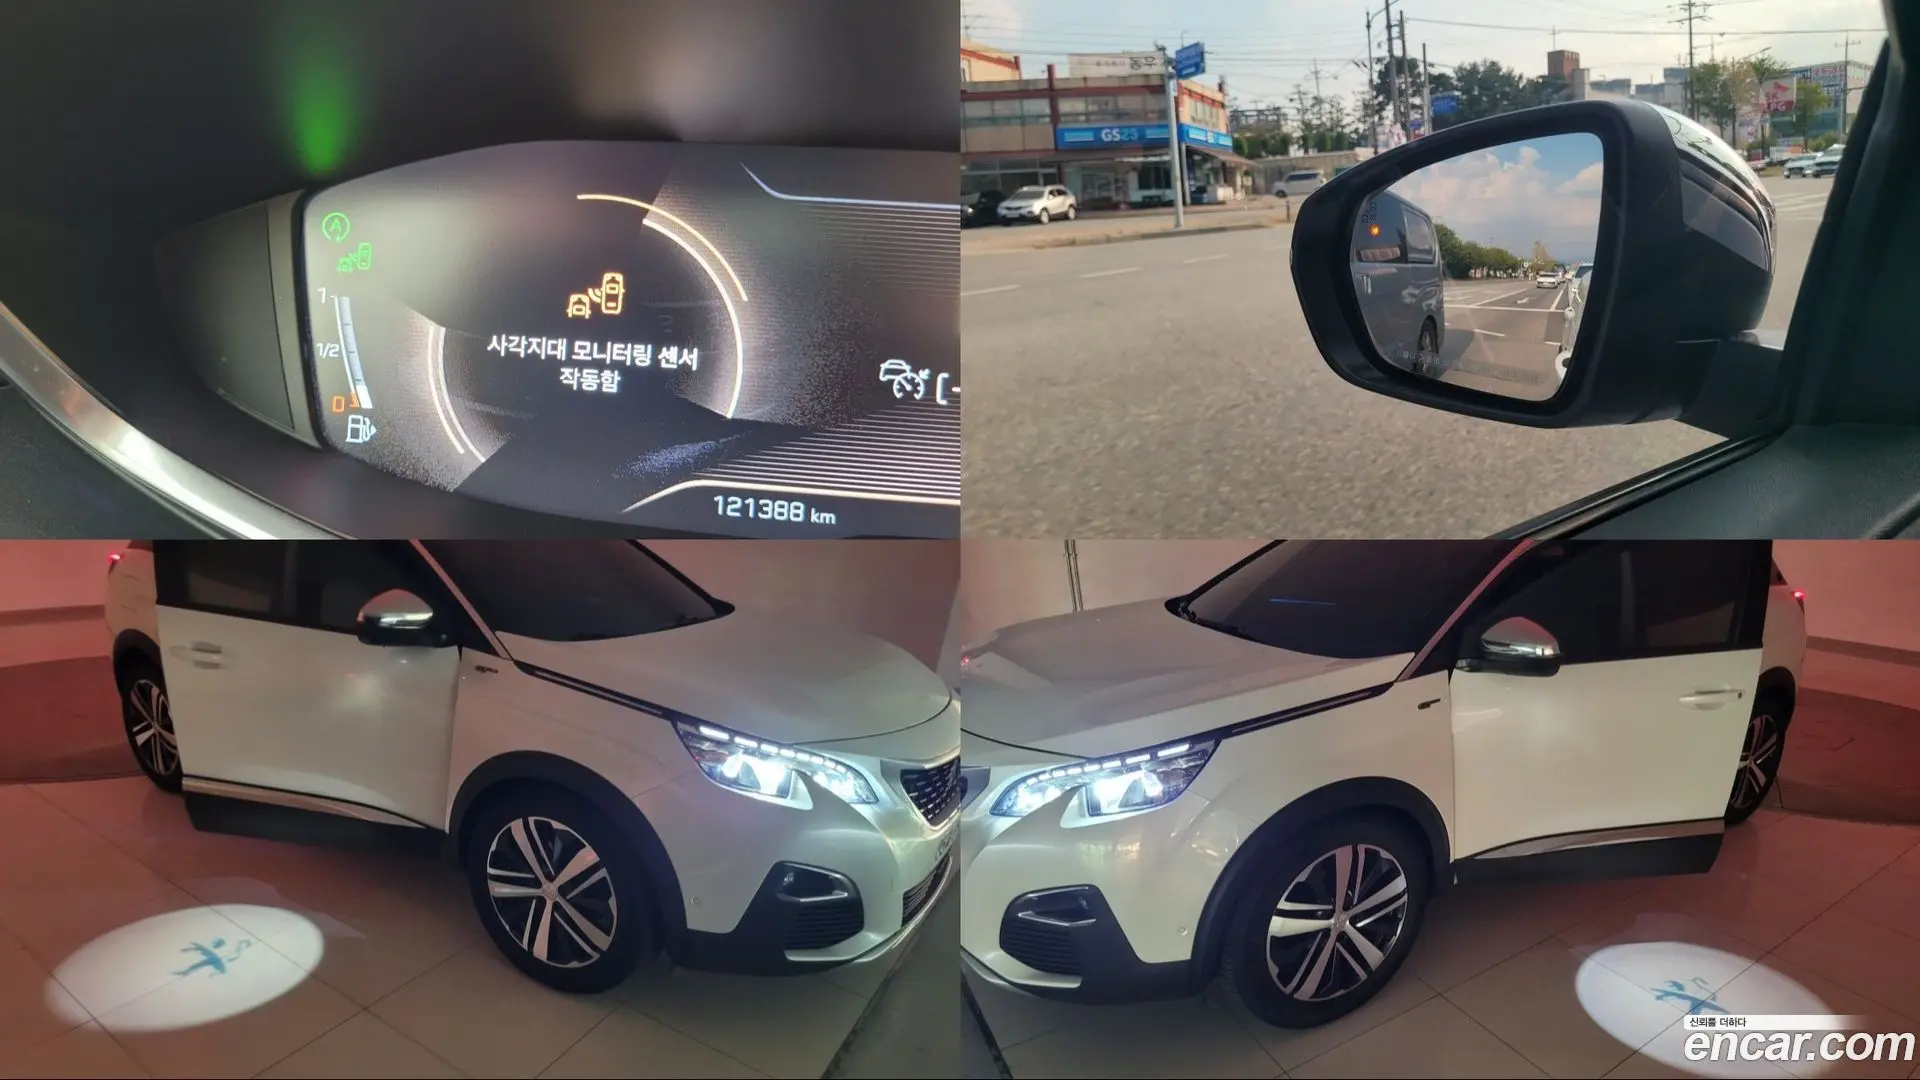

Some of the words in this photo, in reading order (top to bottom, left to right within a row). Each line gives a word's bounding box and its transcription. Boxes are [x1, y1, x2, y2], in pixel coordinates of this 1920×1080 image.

[1101, 128, 1139, 142] GS25
[316, 342, 340, 359] 1/2
[487, 334, 567, 361] 사각지대
[571, 340, 652, 367] 모니터링
[658, 346, 698, 371] 센서
[560, 367, 621, 393] 작동함
[713, 495, 805, 522] 121388
[810, 507, 836, 525] km
